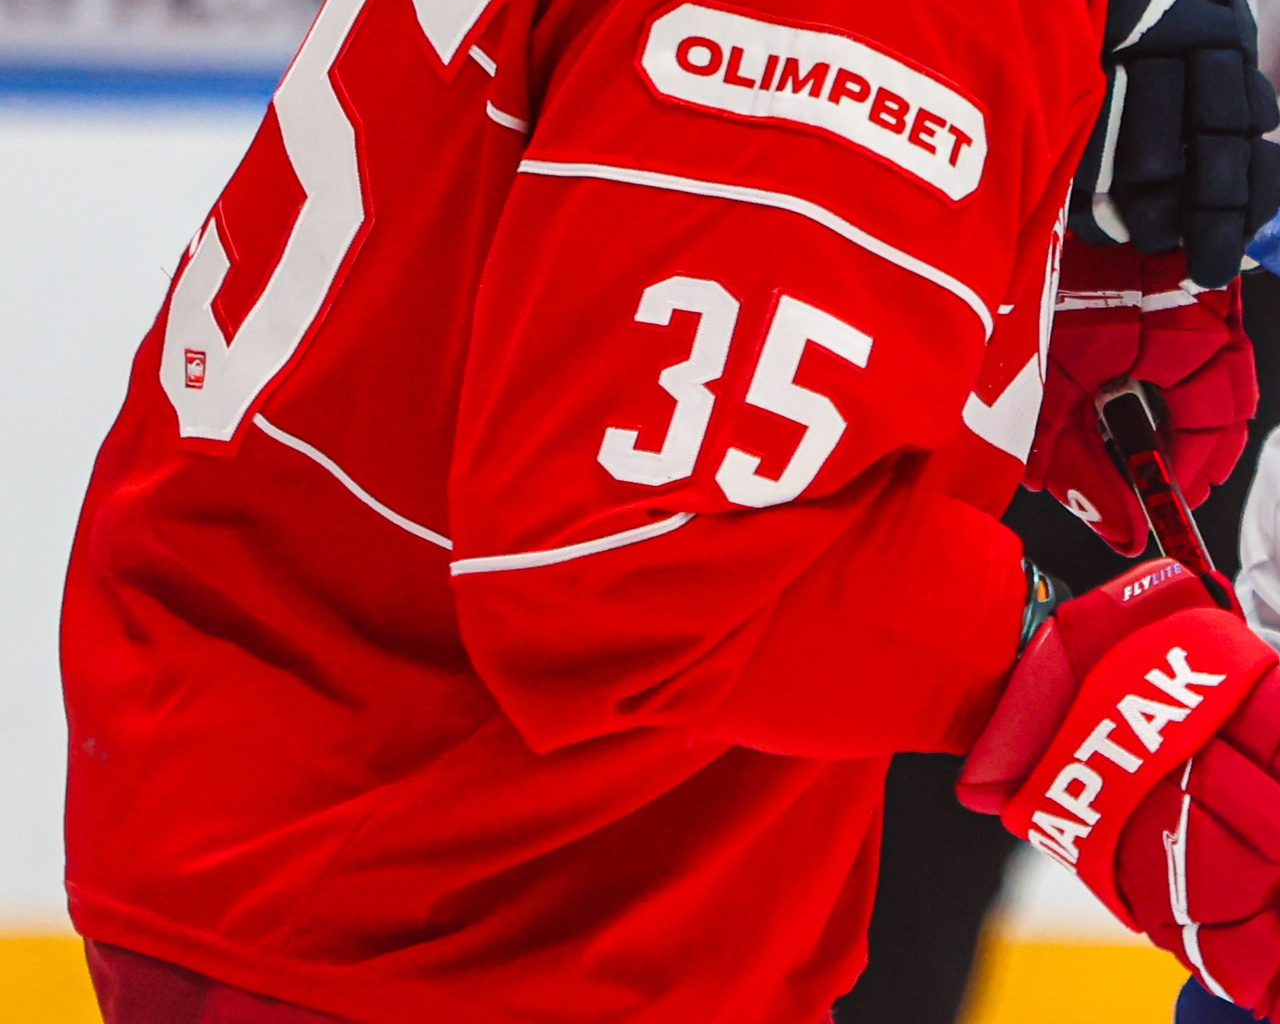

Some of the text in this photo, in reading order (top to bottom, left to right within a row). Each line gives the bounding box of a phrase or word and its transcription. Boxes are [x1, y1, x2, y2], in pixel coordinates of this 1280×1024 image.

[675, 35, 972, 169] OLIMPBET
[596, 275, 874, 508] 35
[1122, 562, 1182, 601] FLYLITE
